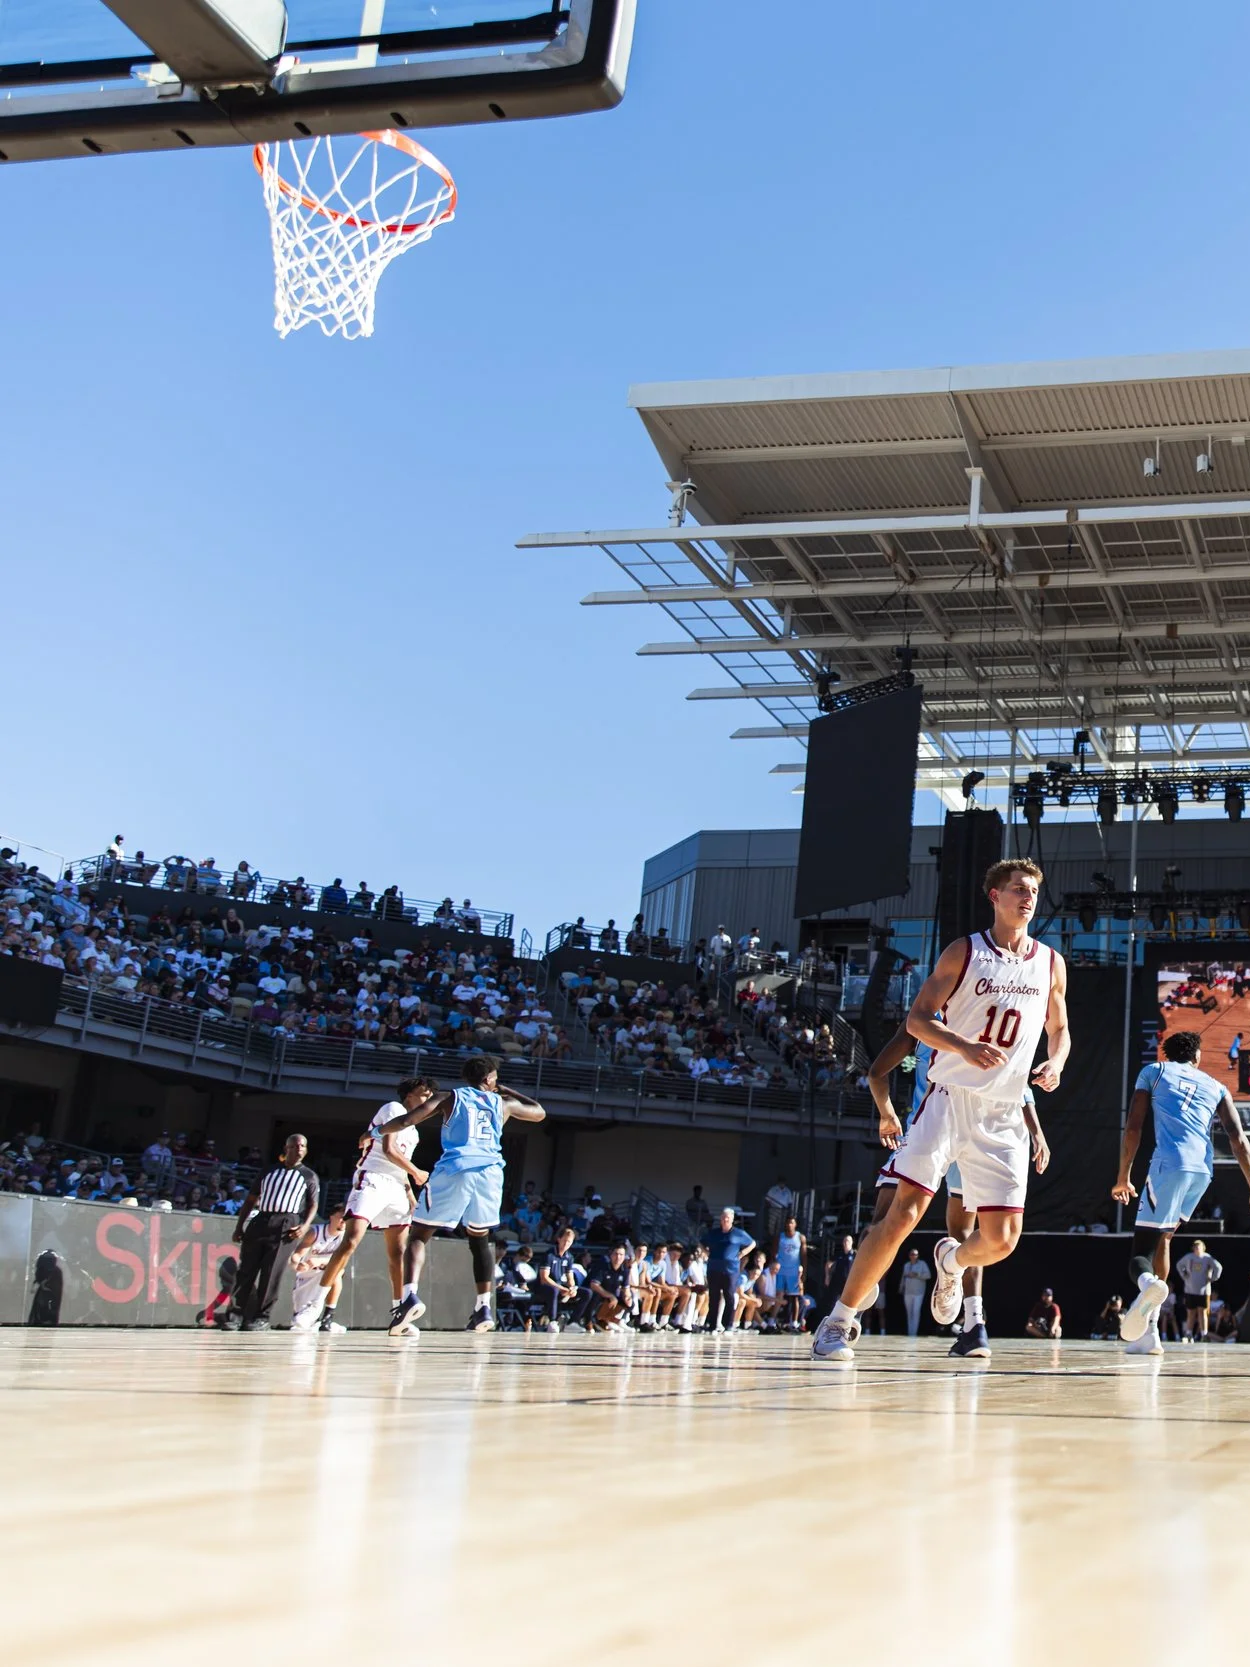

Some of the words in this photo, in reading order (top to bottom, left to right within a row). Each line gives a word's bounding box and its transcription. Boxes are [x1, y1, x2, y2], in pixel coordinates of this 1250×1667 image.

[975, 978, 1040, 996] Charleston
[979, 1005, 1022, 1048] 10
[1178, 1080, 1198, 1111] 7
[468, 1107, 492, 1140] 12
